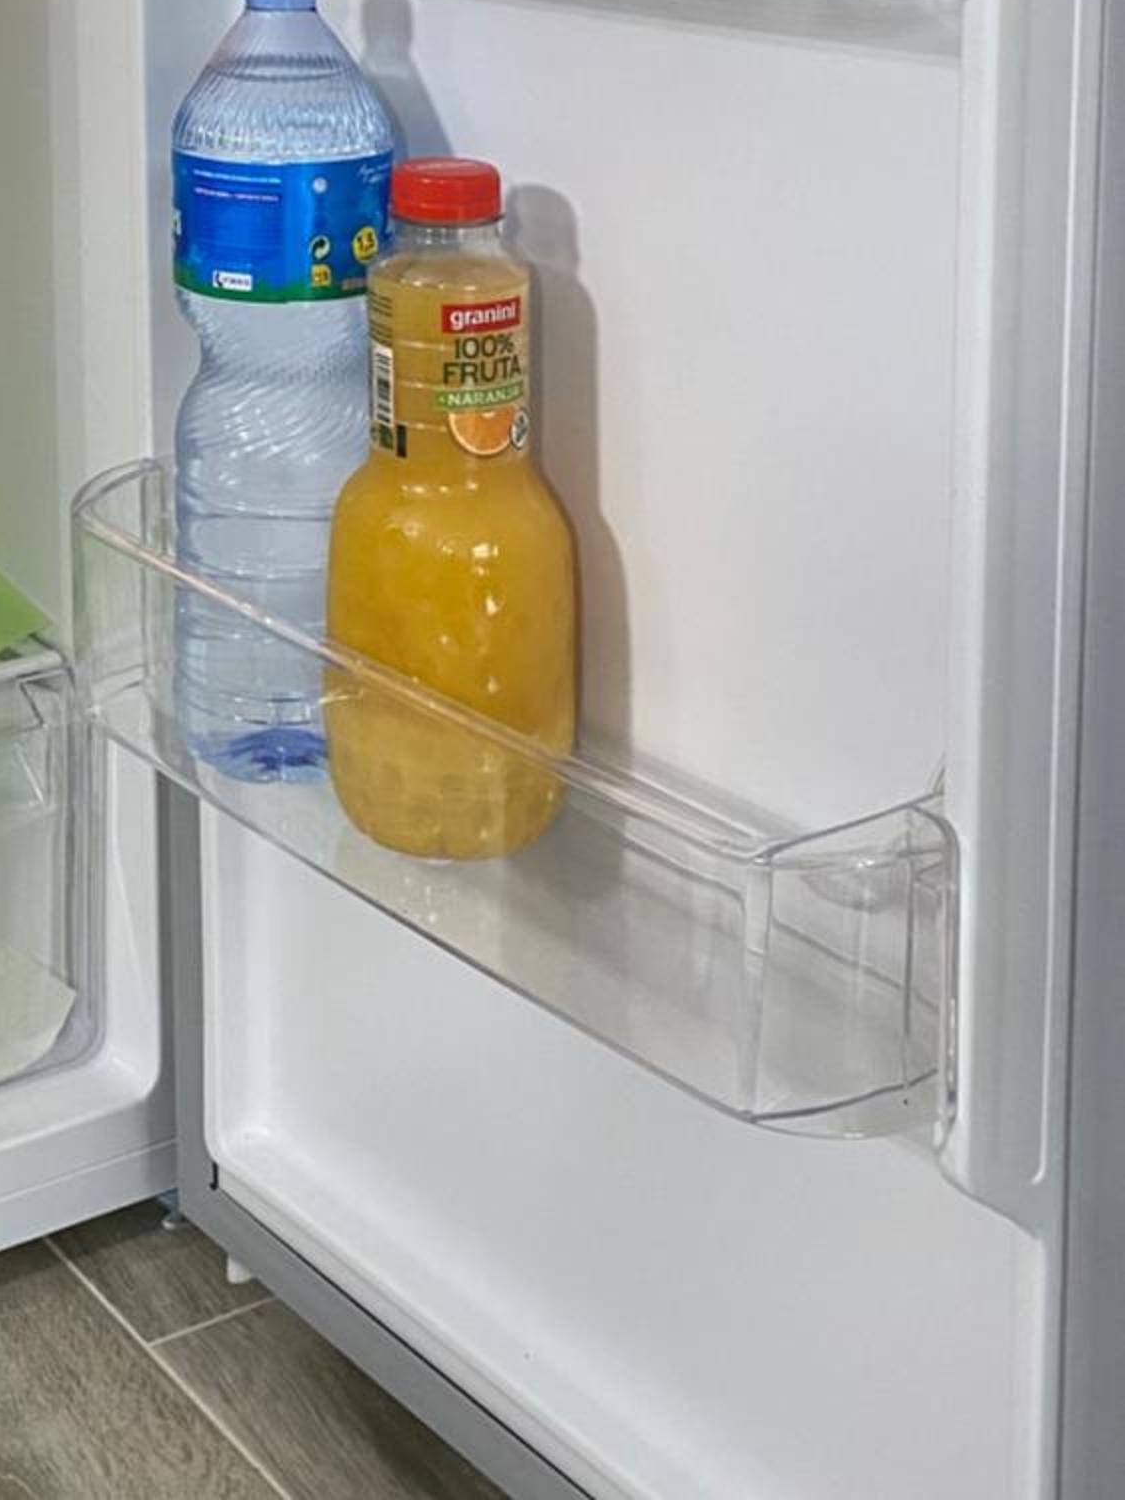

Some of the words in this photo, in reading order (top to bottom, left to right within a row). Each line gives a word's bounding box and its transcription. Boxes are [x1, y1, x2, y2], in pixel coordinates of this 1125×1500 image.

[449, 301, 517, 331] granini
[454, 333, 514, 360] 100%
[443, 354, 521, 386] FRUTA
